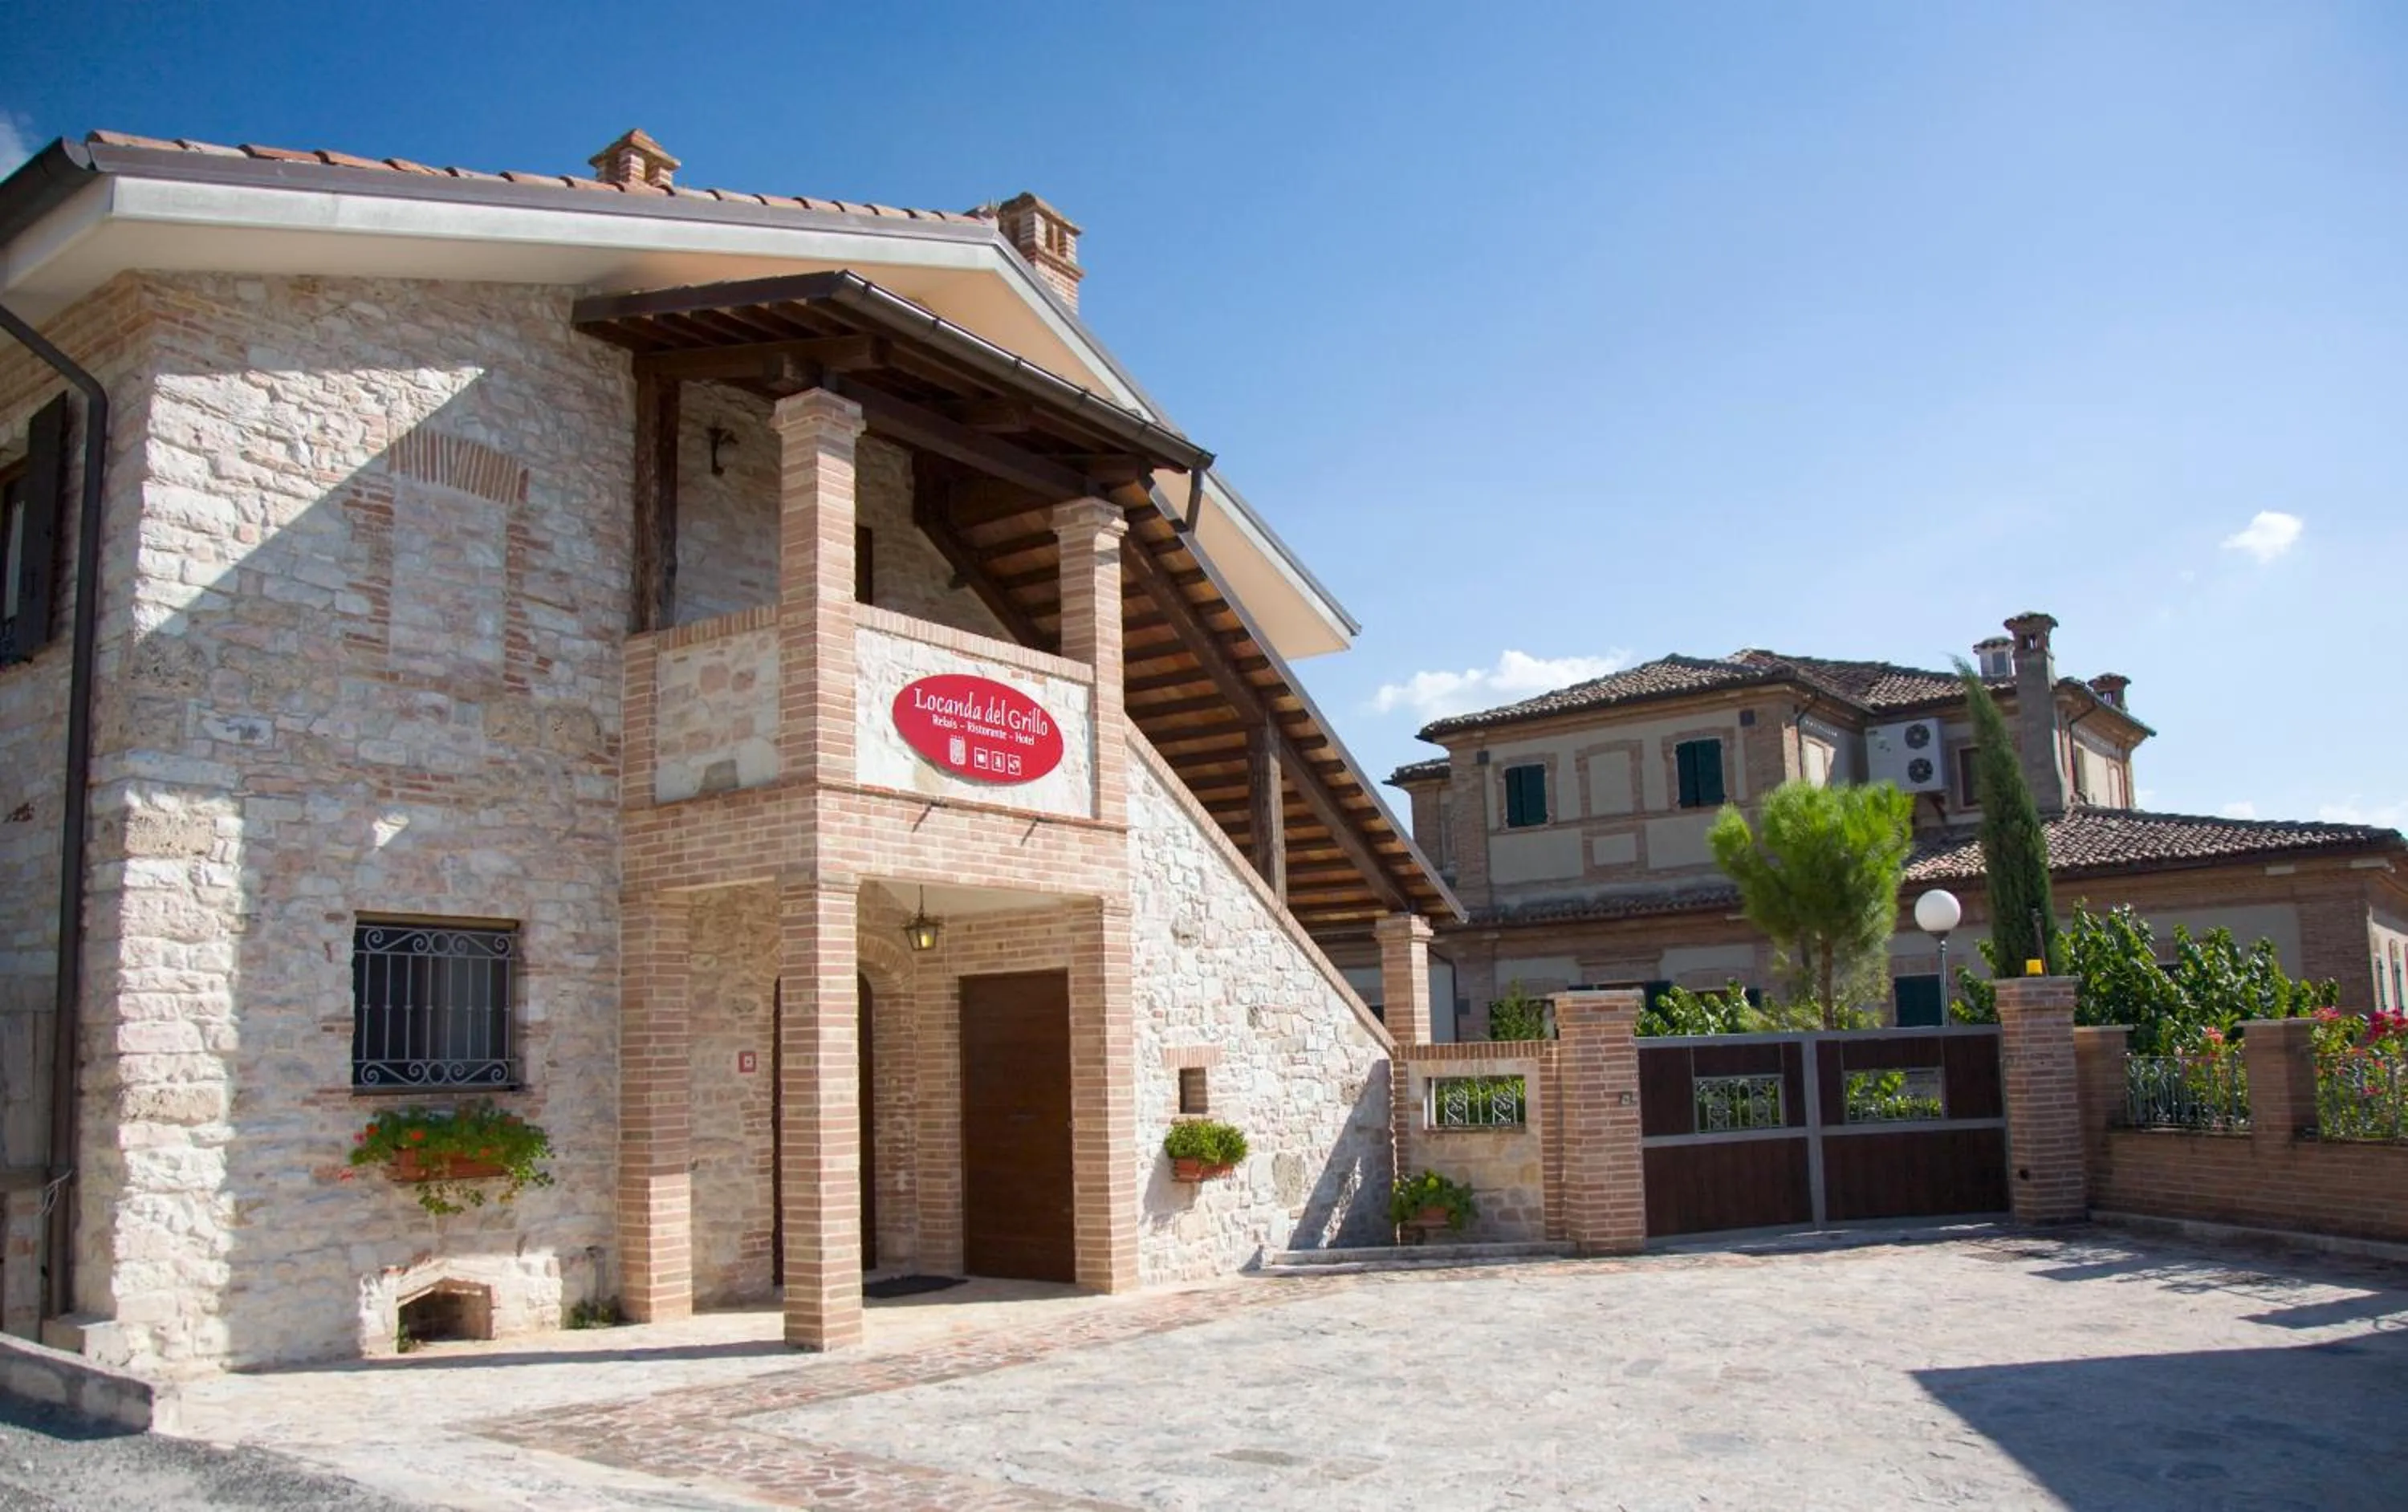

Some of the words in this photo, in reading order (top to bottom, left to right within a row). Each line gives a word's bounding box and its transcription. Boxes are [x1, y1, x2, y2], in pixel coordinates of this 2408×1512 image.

[914, 689, 982, 720] Locanda
[985, 696, 1006, 726] del
[1008, 707, 1047, 736] Grillo
[932, 713, 958, 730] Relais
[967, 721, 1007, 740] Ristorante
[1015, 732, 1035, 746] Hotel
